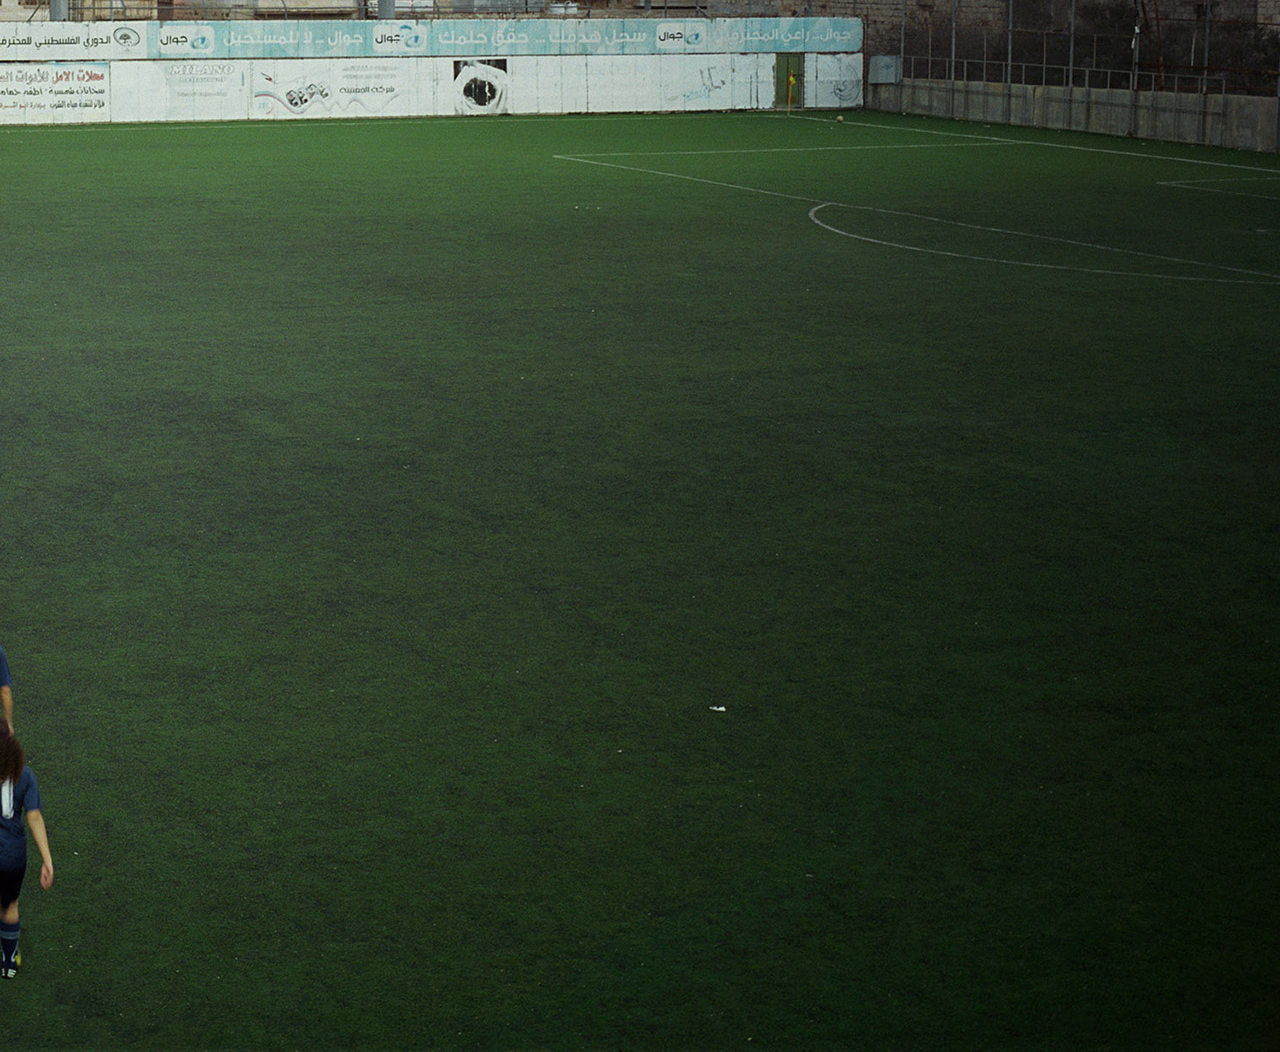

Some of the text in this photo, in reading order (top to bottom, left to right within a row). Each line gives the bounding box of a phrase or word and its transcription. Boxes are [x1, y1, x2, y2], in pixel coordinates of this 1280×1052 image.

[83, 34, 111, 49] الدوري
[160, 34, 188, 46] جوال
[327, 31, 364, 46] جوال
[375, 34, 401, 44] جوال
[658, 31, 683, 42] جوال
[35, 35, 80, 51] الفلسطيني
[170, 64, 235, 75] MILANO
